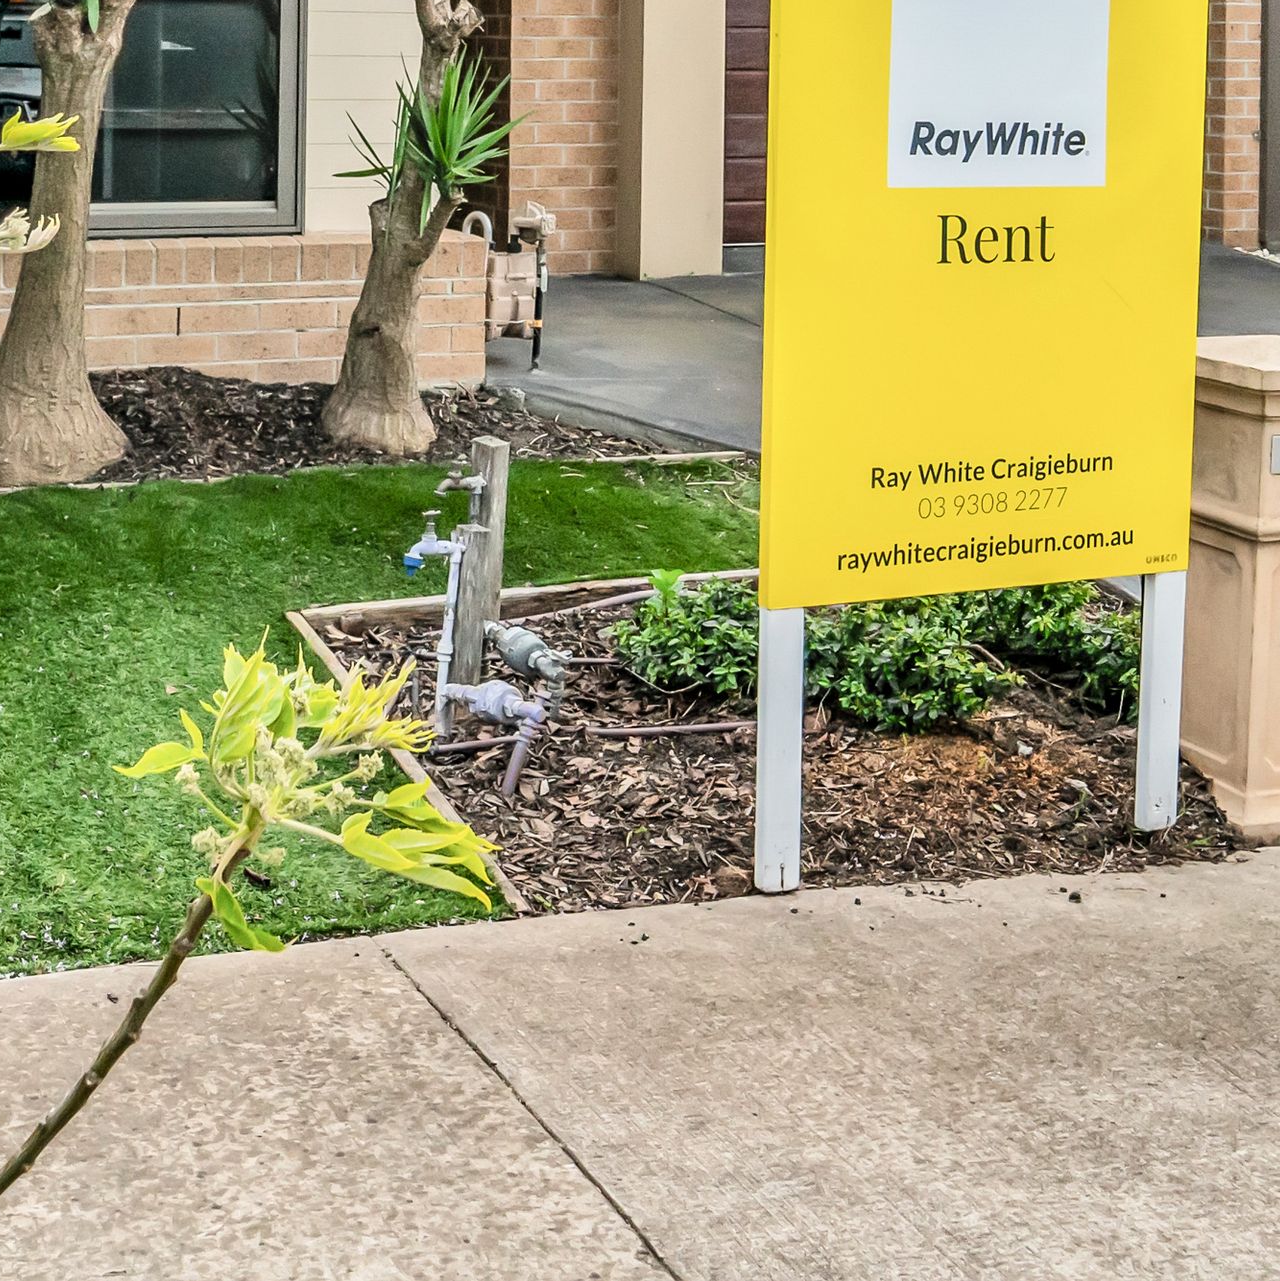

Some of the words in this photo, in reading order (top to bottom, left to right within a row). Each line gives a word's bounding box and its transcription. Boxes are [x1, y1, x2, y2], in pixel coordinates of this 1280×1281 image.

[936, 214, 1056, 264] Rent
[870, 467, 912, 491] Ray
[917, 461, 985, 485] White
[990, 452, 1114, 481] Craigieburn
[917, 496, 946, 519] 03
[953, 491, 1008, 517] 9308
[1014, 486, 1069, 512] 2277
[836, 528, 1134, 573] raywhitecraigieburn.com.au
